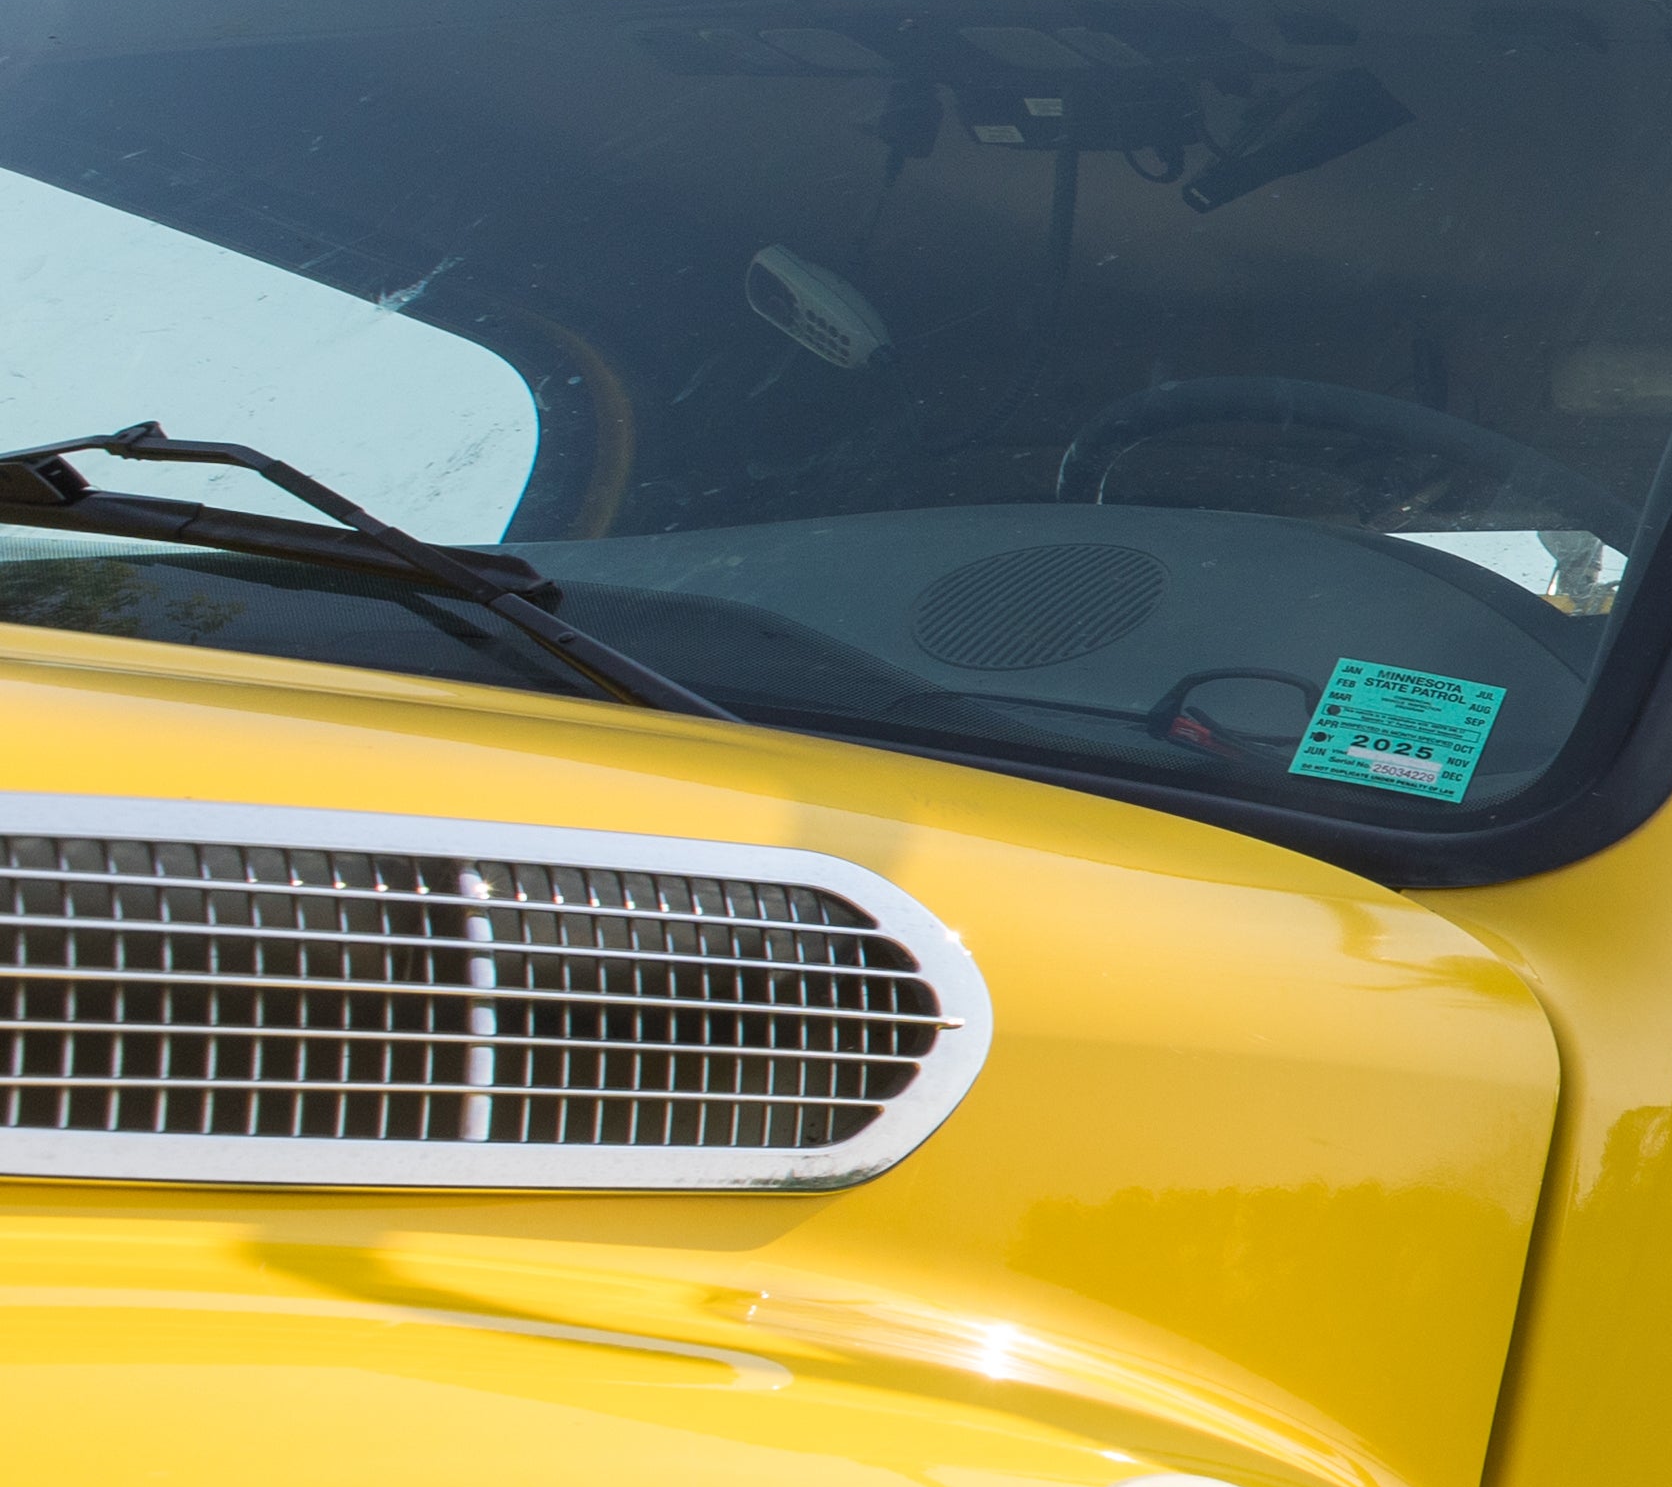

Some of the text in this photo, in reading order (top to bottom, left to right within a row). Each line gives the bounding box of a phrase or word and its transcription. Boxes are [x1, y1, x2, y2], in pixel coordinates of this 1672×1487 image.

[1341, 664, 1363, 675] JAN
[1335, 677, 1356, 688] FEB
[1378, 670, 1463, 693] MINNESOTA
[1363, 676, 1469, 704] STATE PATROL
[1474, 690, 1496, 700] JUL
[1467, 702, 1492, 714] AUG
[1316, 718, 1339, 728] APR
[1463, 716, 1485, 727] SEP
[1303, 745, 1326, 756] JUN
[1350, 734, 1434, 759] 2025
[1452, 743, 1474, 754] OCT
[1445, 757, 1469, 768] NOV
[1372, 763, 1435, 782] 25034229
[1440, 770, 1463, 781] DEC
